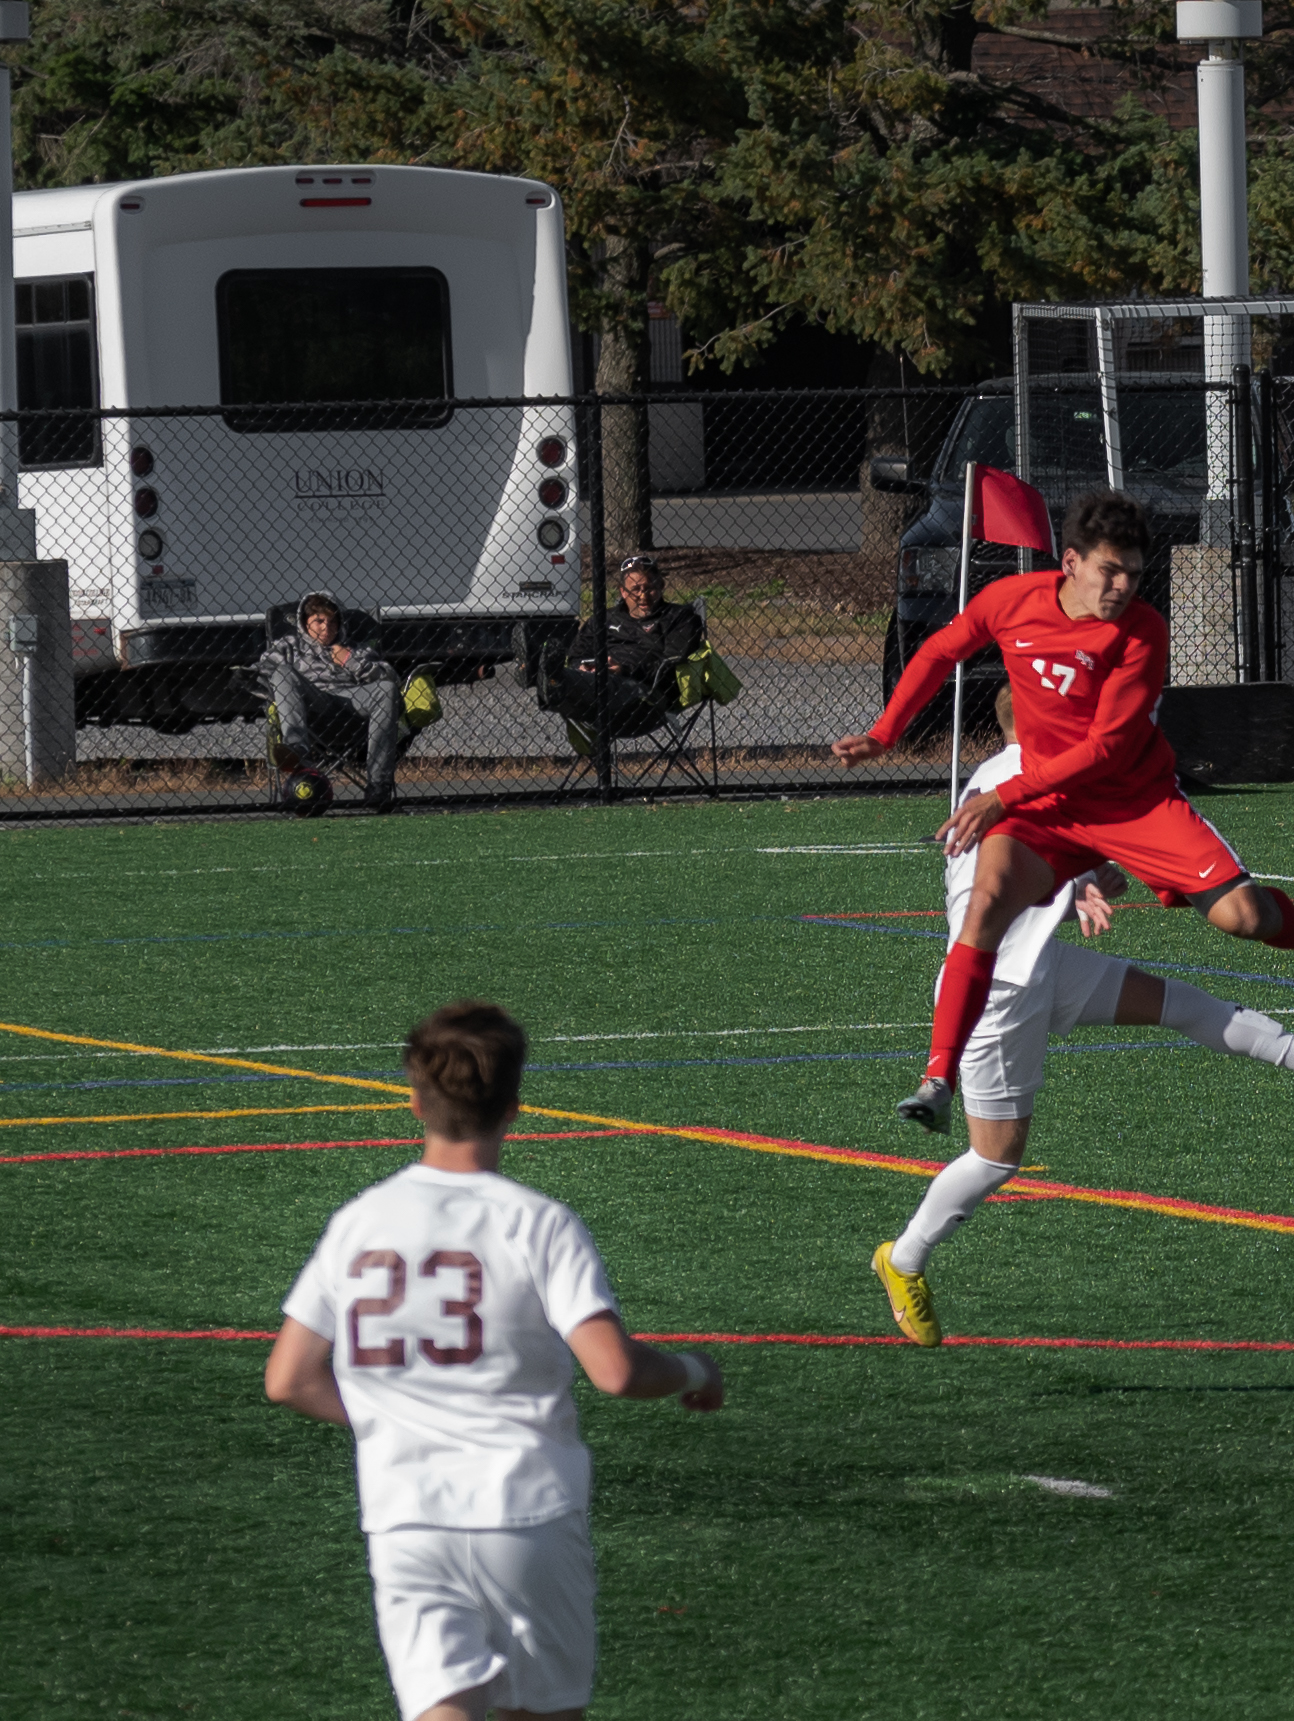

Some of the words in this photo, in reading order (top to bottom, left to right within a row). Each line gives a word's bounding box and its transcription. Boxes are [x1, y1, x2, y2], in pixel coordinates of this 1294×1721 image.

[295, 469, 384, 493] UNION
[1031, 658, 1076, 697] 17
[347, 1249, 483, 1366] 23
